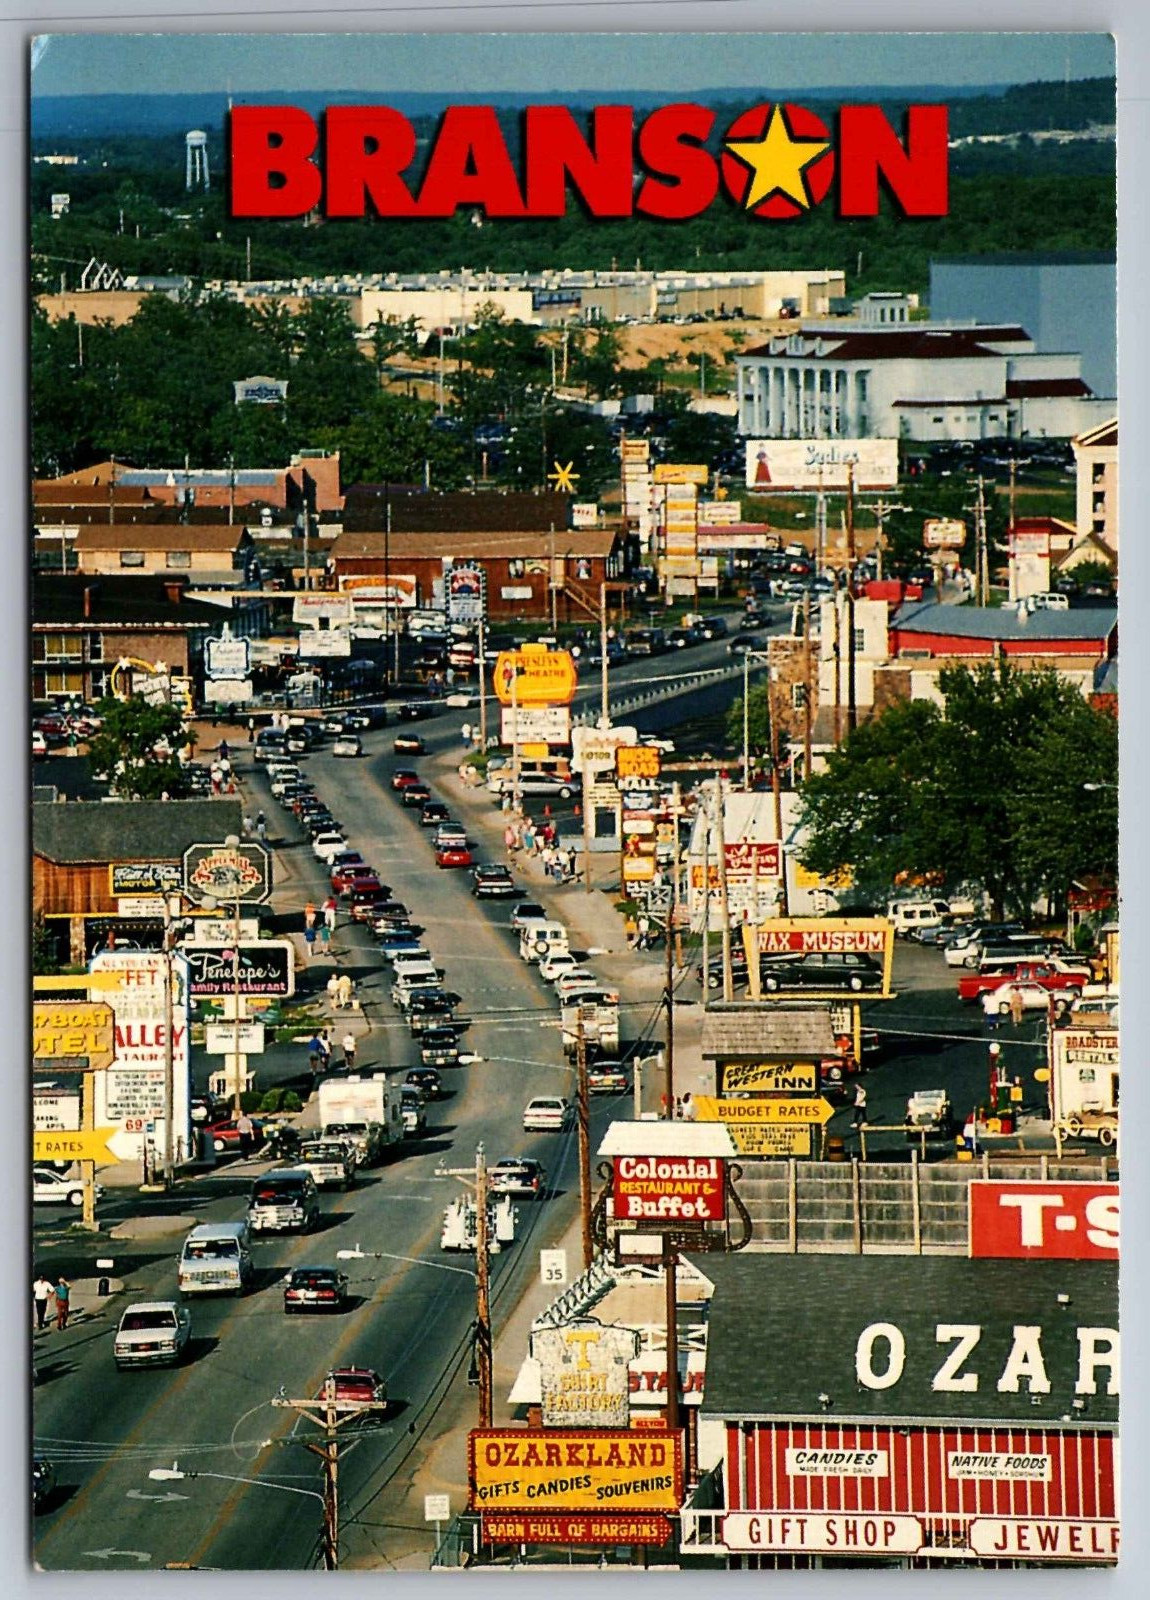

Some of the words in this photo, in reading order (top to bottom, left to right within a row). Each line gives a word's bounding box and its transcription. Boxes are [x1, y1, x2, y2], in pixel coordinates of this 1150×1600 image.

[802, 931, 885, 952] MUSEUM
[188, 952, 280, 985] Peneope's
[190, 982, 220, 992] amily
[727, 1064, 795, 1090] WESTERN
[774, 1077, 813, 1089] INN
[718, 1105, 771, 1117] BUDGET
[779, 1105, 821, 1117] RATES
[45, 1140, 84, 1153] RATES
[619, 1157, 719, 1180] Colonial
[619, 1181, 704, 1196] RESTAURANT
[626, 1195, 712, 1218] Buffet
[545, 1268, 564, 1281] 35
[566, 1330, 601, 1370] T
[484, 1442, 667, 1467] OZARKLAND
[795, 1451, 879, 1466] CANDIES
[951, 1455, 1001, 1470] NATIVE
[1004, 1457, 1048, 1470] FOODS
[478, 1480, 521, 1500] GIFTS
[526, 1475, 593, 1499] CANDIES
[596, 1475, 673, 1500] SOUVENIRS
[488, 1523, 525, 1538] BARN
[529, 1523, 561, 1538] FULL
[567, 1523, 587, 1538] OF
[591, 1523, 659, 1538] BARGAINS
[748, 1518, 808, 1545] GIFT
[825, 1519, 896, 1547] SHOP
